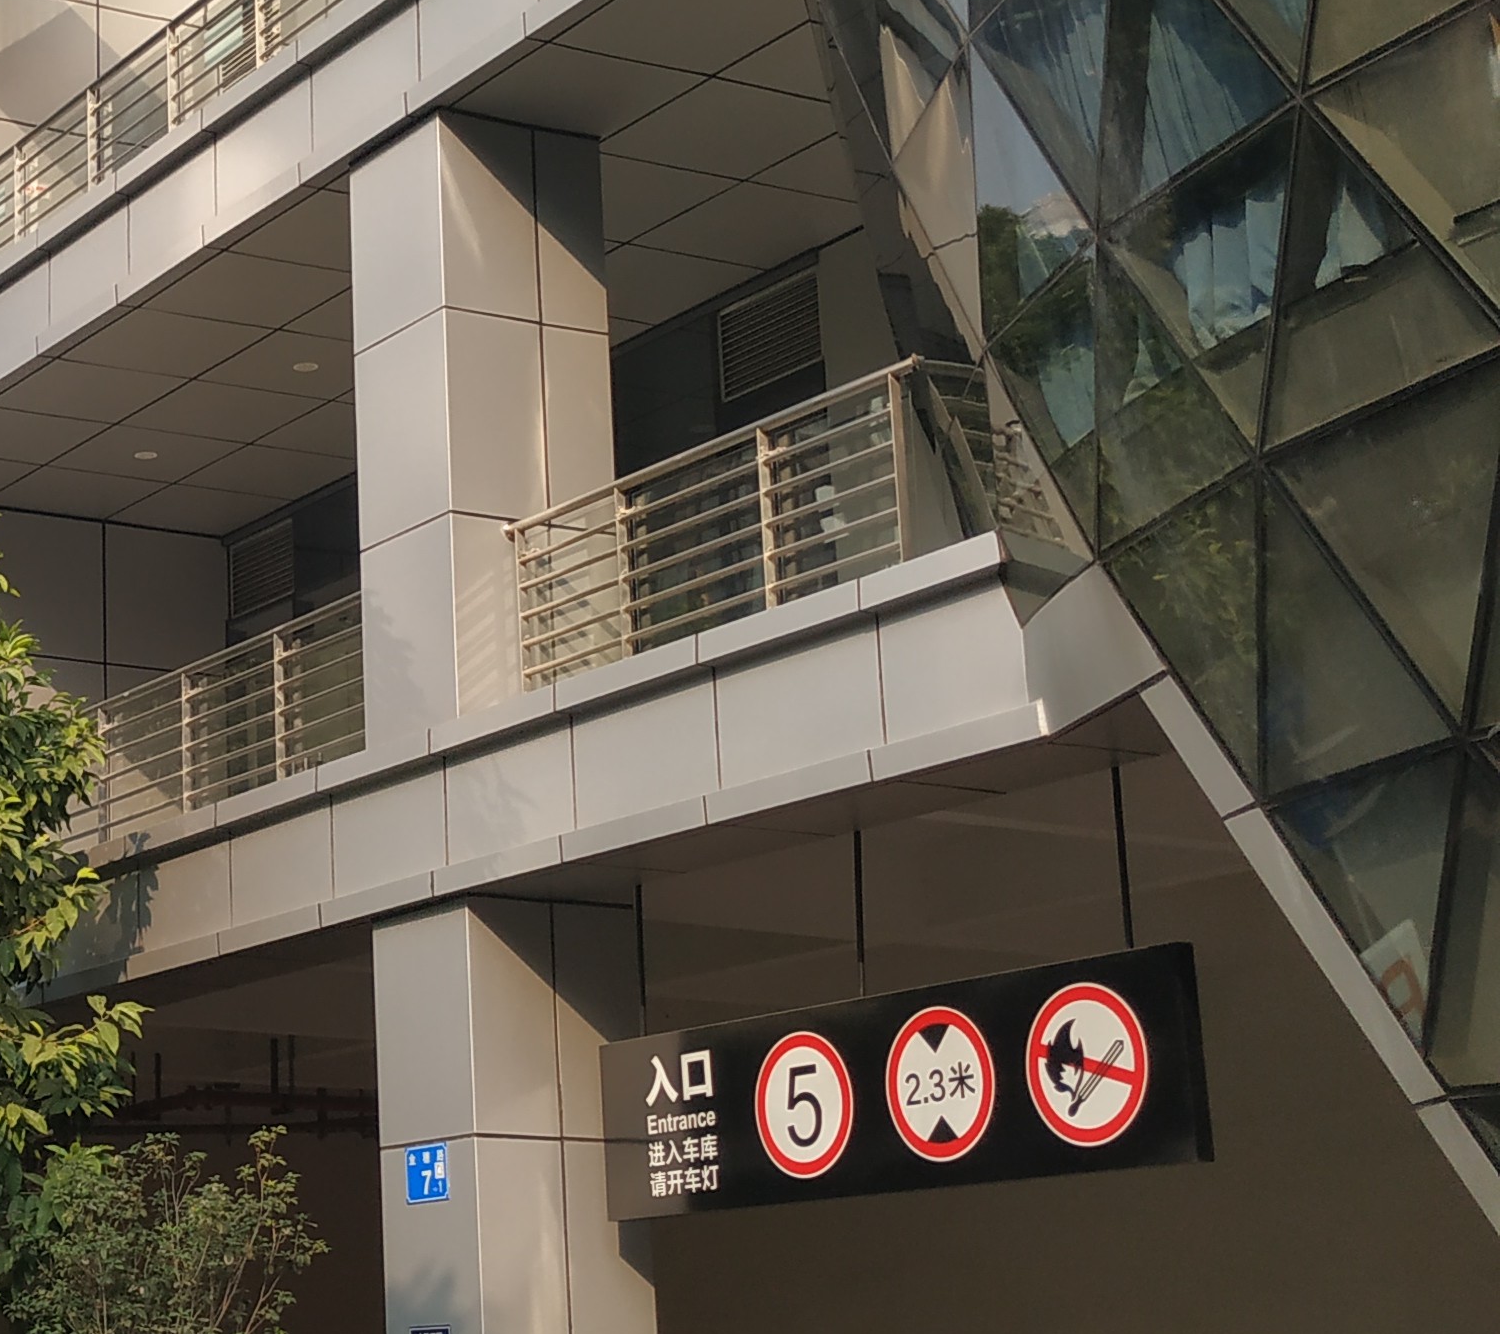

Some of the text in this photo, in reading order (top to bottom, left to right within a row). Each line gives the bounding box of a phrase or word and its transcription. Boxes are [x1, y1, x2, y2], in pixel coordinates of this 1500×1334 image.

[645, 1049, 714, 1107] 入口
[904, 1060, 977, 1107] 2.3米
[647, 1110, 716, 1135] Entrance
[786, 1063, 822, 1148] 5
[648, 1134, 719, 1167] 进入车库
[650, 1165, 719, 1198] 请开车灯
